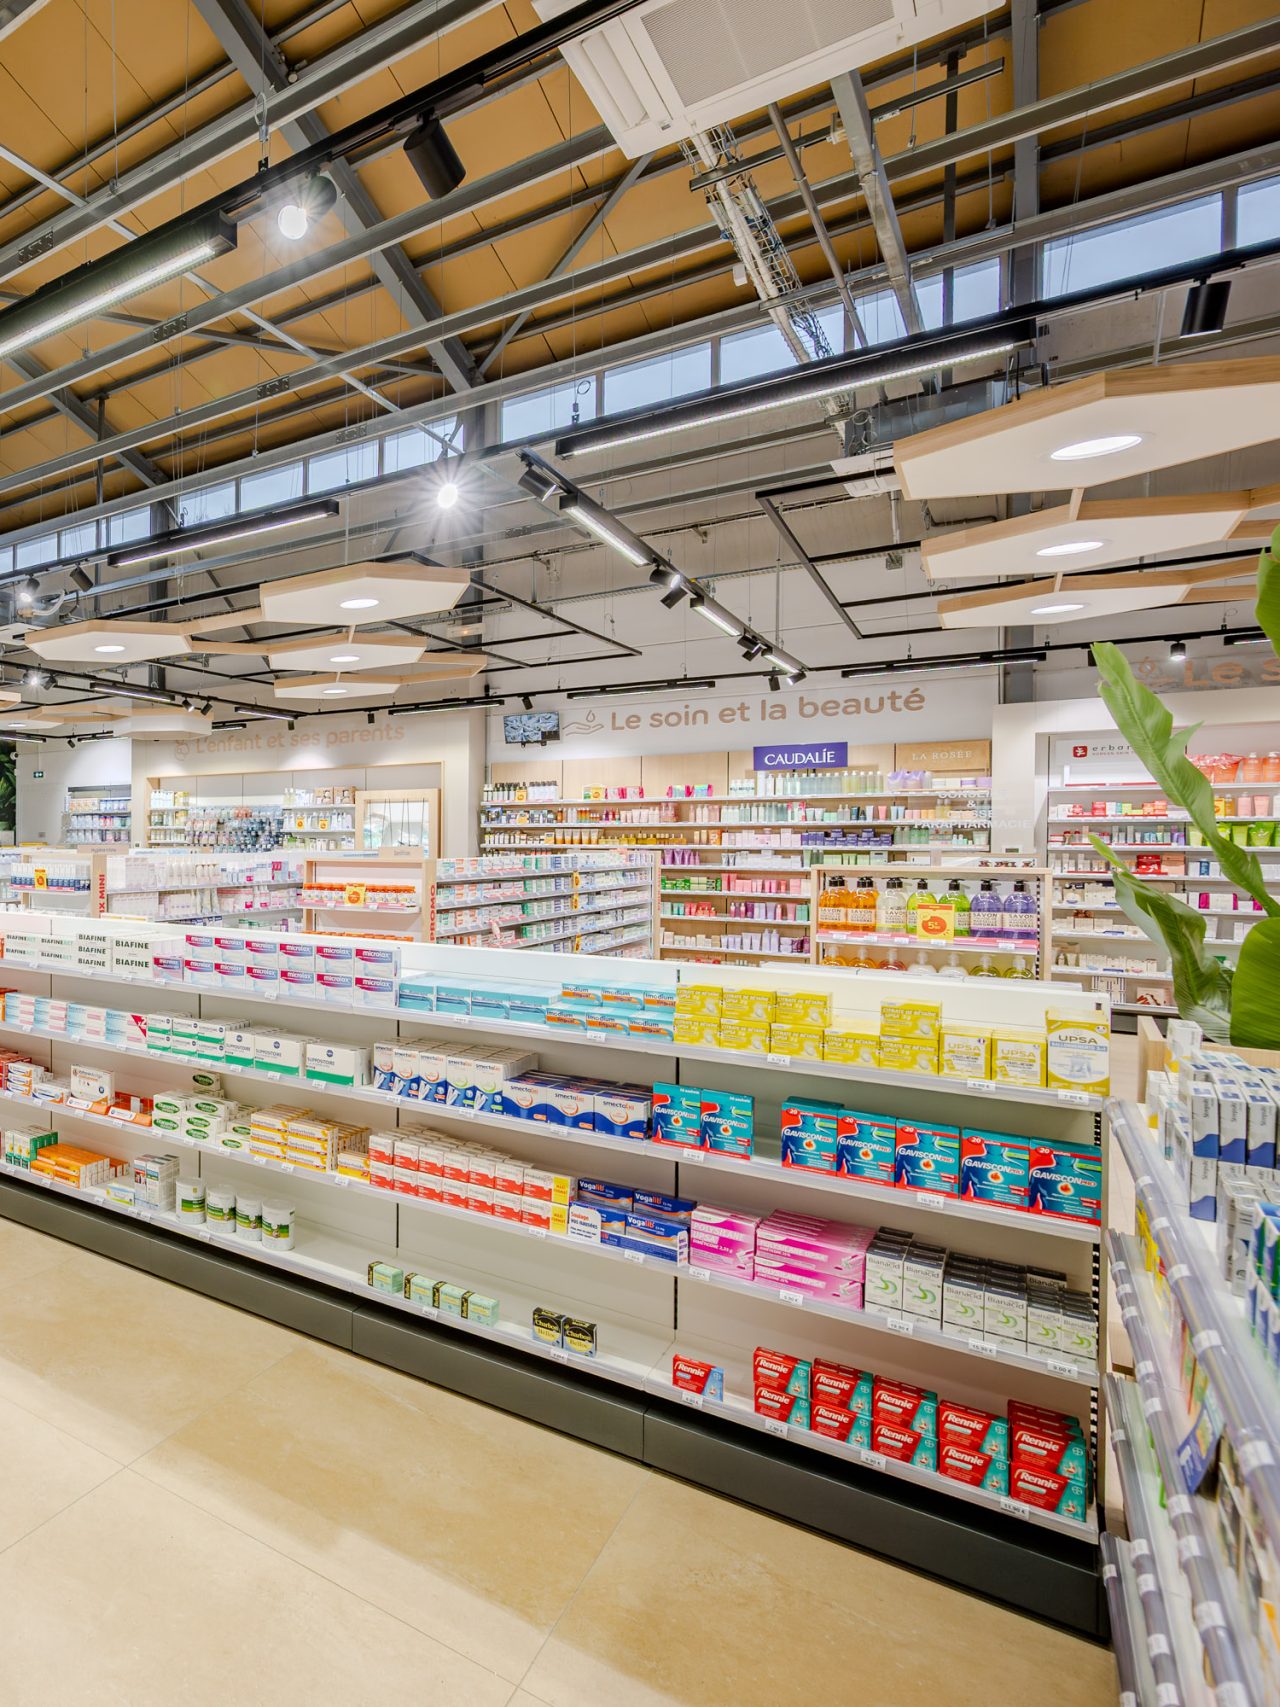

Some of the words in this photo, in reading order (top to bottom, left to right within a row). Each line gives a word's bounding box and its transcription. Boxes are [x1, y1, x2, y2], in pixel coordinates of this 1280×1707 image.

[1183, 660, 1244, 687] Le
[611, 711, 641, 731] Le
[649, 704, 709, 729] soin
[718, 701, 751, 724] et
[761, 699, 787, 721] la
[799, 687, 926, 719] beauté
[266, 733, 285, 748] et
[291, 731, 320, 747] ses
[326, 723, 405, 748] parents
[912, 753, 927, 761] LA
[78, 933, 107, 943] BIAFINE
[115, 940, 149, 950] BIAFINE
[78, 946, 106, 955] BIAFINE
[78, 958, 106, 967] BIAFINE
[115, 958, 150, 968] BIAFINE
[1059, 1034, 1098, 1044] UPSA
[948, 1043, 980, 1051] UPSA
[1001, 1049, 1036, 1057] UPSA
[580, 1181, 605, 1192] Vogalib
[635, 1193, 662, 1205] Vogalib
[627, 1216, 654, 1229] Vogalib
[868, 1257, 900, 1270] Bianacid
[906, 1265, 939, 1278] Bianacid
[946, 1286, 982, 1300] Bianacid
[987, 1296, 1024, 1310] Bianacid
[678, 1363, 705, 1378] Rennie
[759, 1359, 789, 1374] Rennie
[819, 1374, 850, 1391] Rennie
[761, 1389, 790, 1405] Rennie
[881, 1393, 913, 1410] Rennie
[819, 1408, 850, 1424] Rennie
[948, 1413, 983, 1432] Rennie
[881, 1427, 914, 1444] Rennie
[1021, 1433, 1059, 1452] Rennie
[948, 1448, 984, 1467] Rennie
[1020, 1471, 1058, 1491] Rennie
